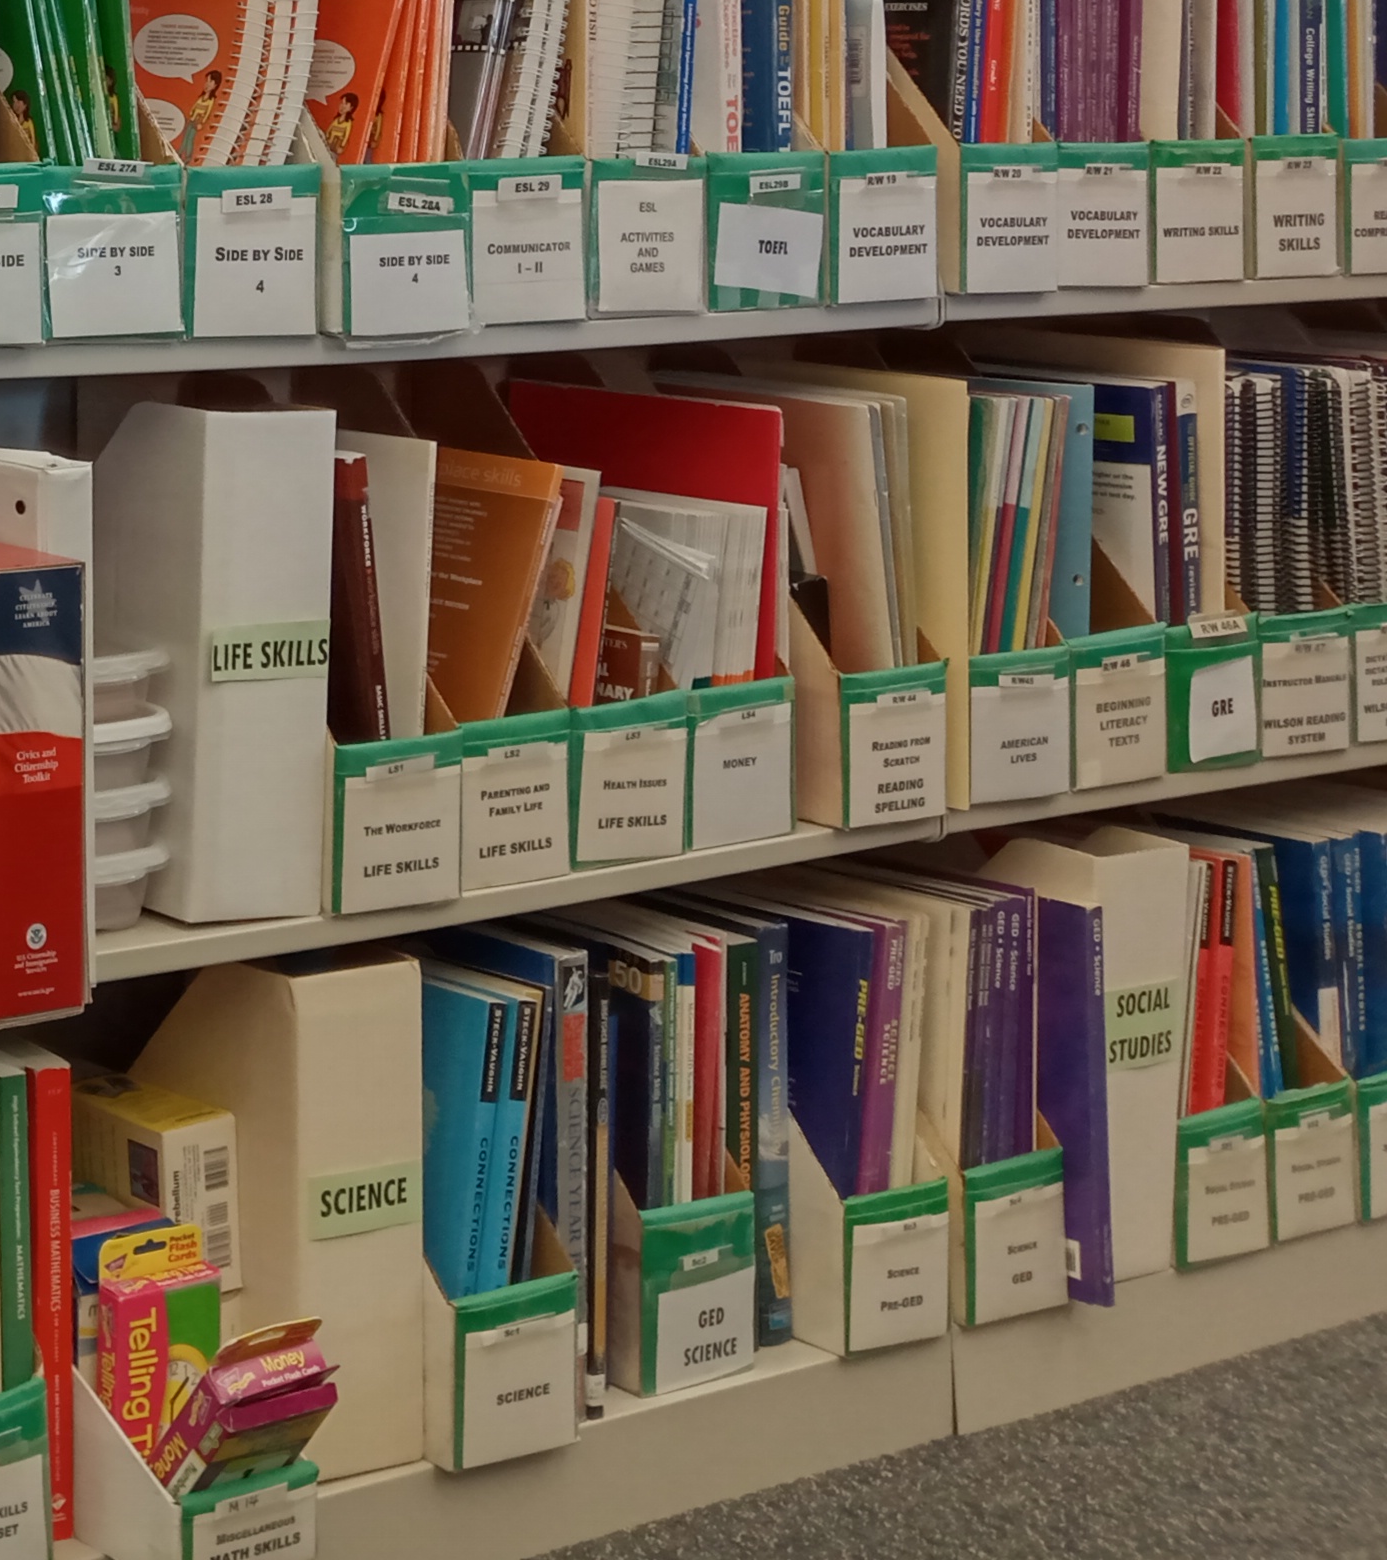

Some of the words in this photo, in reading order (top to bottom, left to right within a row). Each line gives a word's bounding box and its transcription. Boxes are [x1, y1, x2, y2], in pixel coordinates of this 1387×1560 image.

[853, 225, 925, 238] VOCABULARY
[1163, 227, 1205, 237] WRITING
[1208, 225, 1239, 236] SKILLS
[759, 240, 787, 254] TOEFL
[850, 243, 927, 257] DEVELOPMENT
[214, 643, 252, 671] LIFE
[261, 639, 327, 668] SKILLS
[1212, 698, 1233, 717] GRE
[1000, 737, 1048, 749] AMERICAN
[1010, 752, 1038, 764] LIVES
[1117, 987, 1170, 1017] SOCIAL
[1109, 1030, 1171, 1063] STUDIES
[321, 1177, 406, 1217] SCIENCE
[699, 1307, 724, 1328] GED
[121, 1306, 157, 1421] Telling
